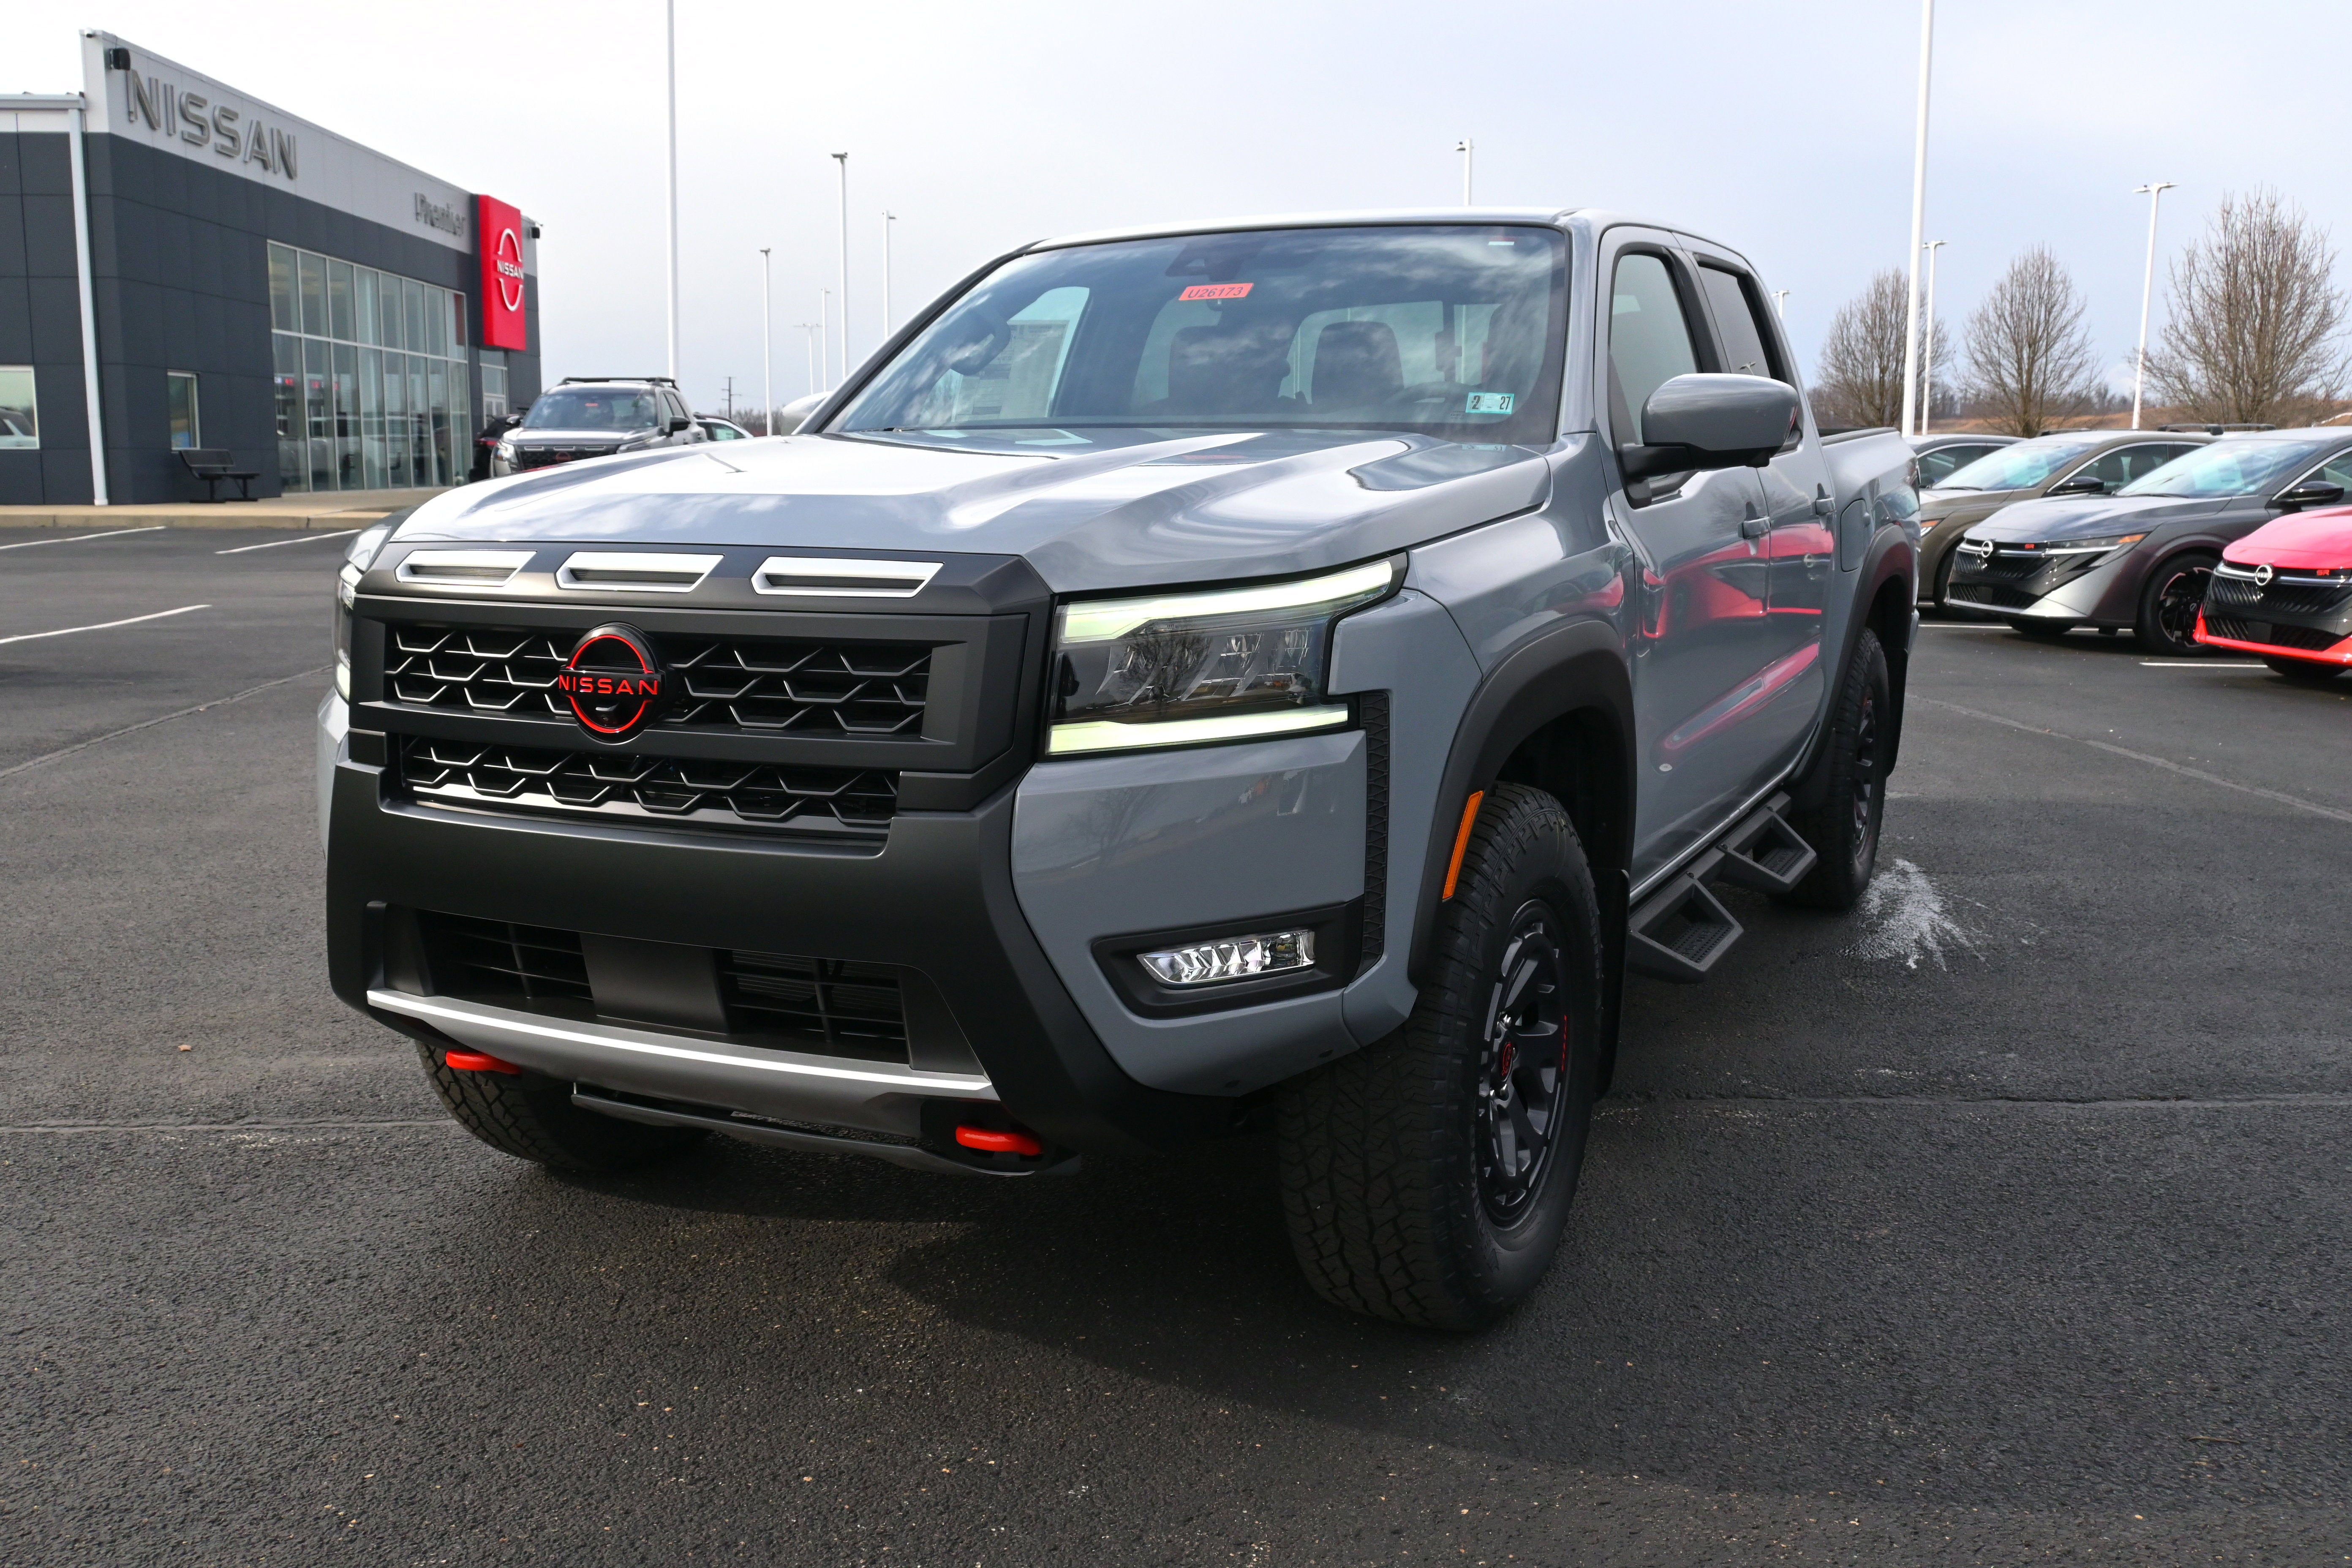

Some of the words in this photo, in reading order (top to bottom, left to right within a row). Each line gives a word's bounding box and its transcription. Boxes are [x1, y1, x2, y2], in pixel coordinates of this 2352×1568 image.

[125, 69, 297, 180] NISSAN
[414, 192, 466, 237] Premier
[497, 259, 523, 279] NISSAN
[1188, 286, 1244, 298] U26173
[1472, 395, 1481, 409] 2
[1500, 396, 1511, 410] 27
[558, 674, 658, 695] NISSAN
